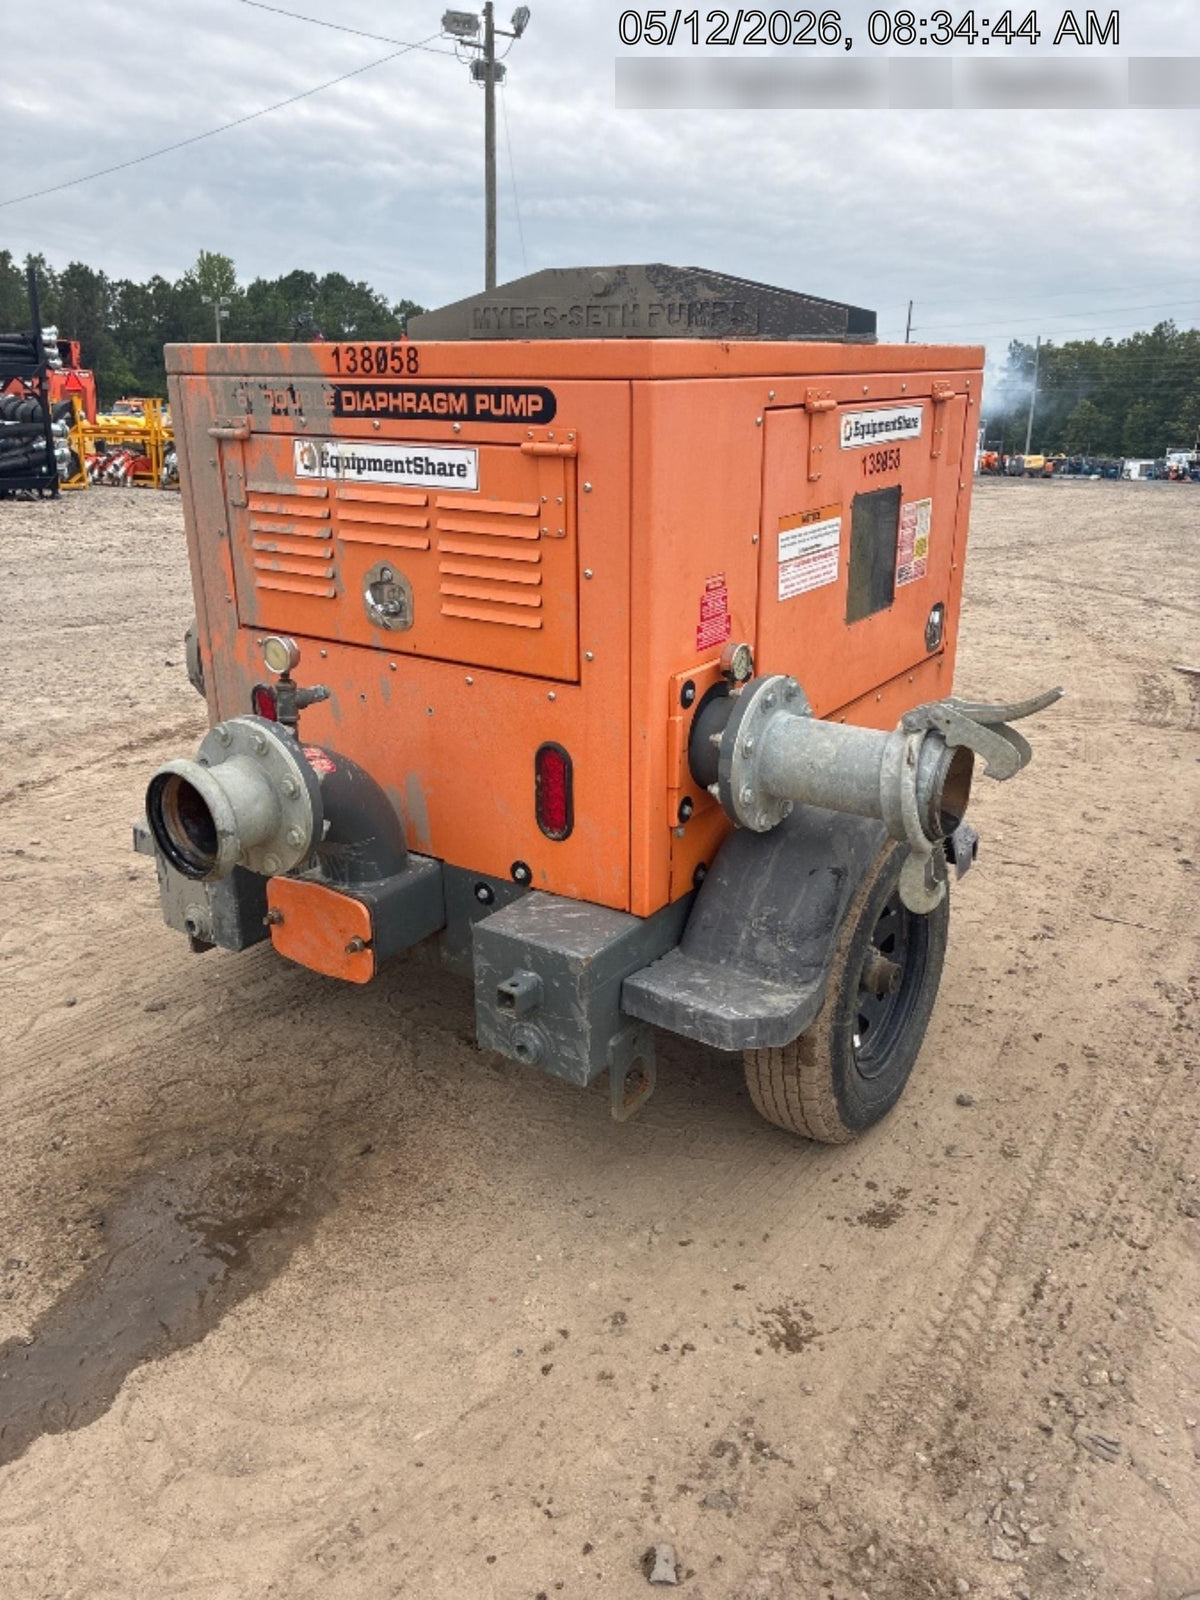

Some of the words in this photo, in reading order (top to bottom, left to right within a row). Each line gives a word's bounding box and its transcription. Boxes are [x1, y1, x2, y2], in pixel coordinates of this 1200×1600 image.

[473, 304, 640, 330] MYERS-SETH
[331, 346, 419, 374] 138058
[340, 390, 468, 415] DIAPHRAGM
[475, 394, 544, 417] PUMP
[321, 450, 468, 478] EquipmentShare
